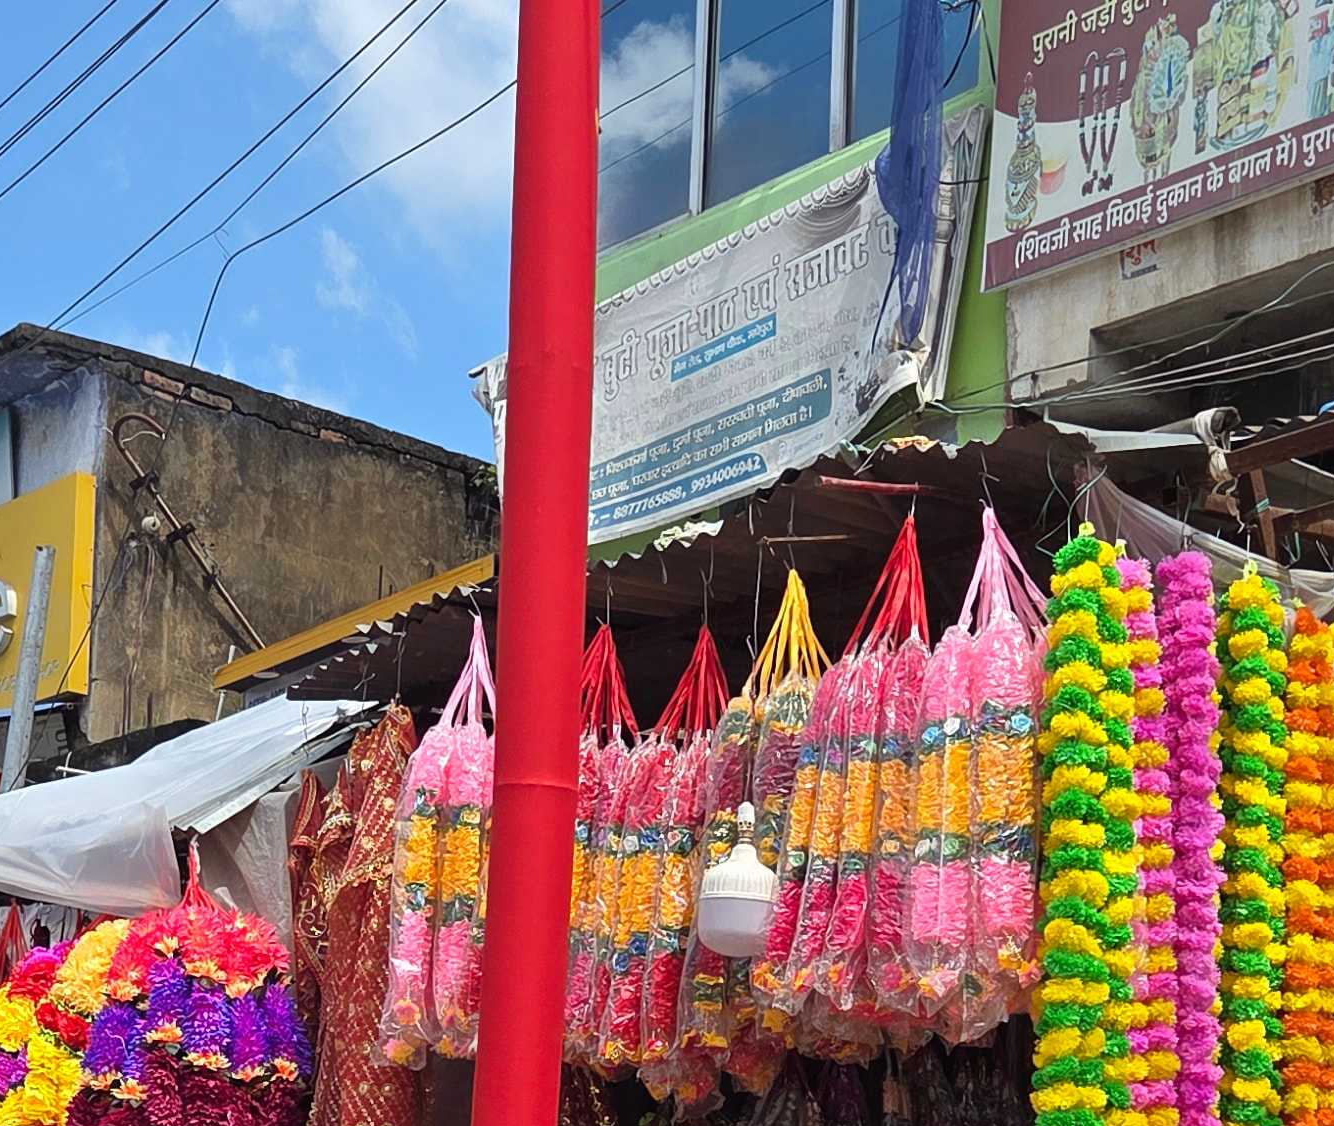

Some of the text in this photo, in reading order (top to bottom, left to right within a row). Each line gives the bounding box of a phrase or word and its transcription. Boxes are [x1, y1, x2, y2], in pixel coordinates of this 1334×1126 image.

[1073, 218, 1103, 244] साह
[1206, 161, 1224, 192] के
[1228, 147, 1273, 185] बगल
